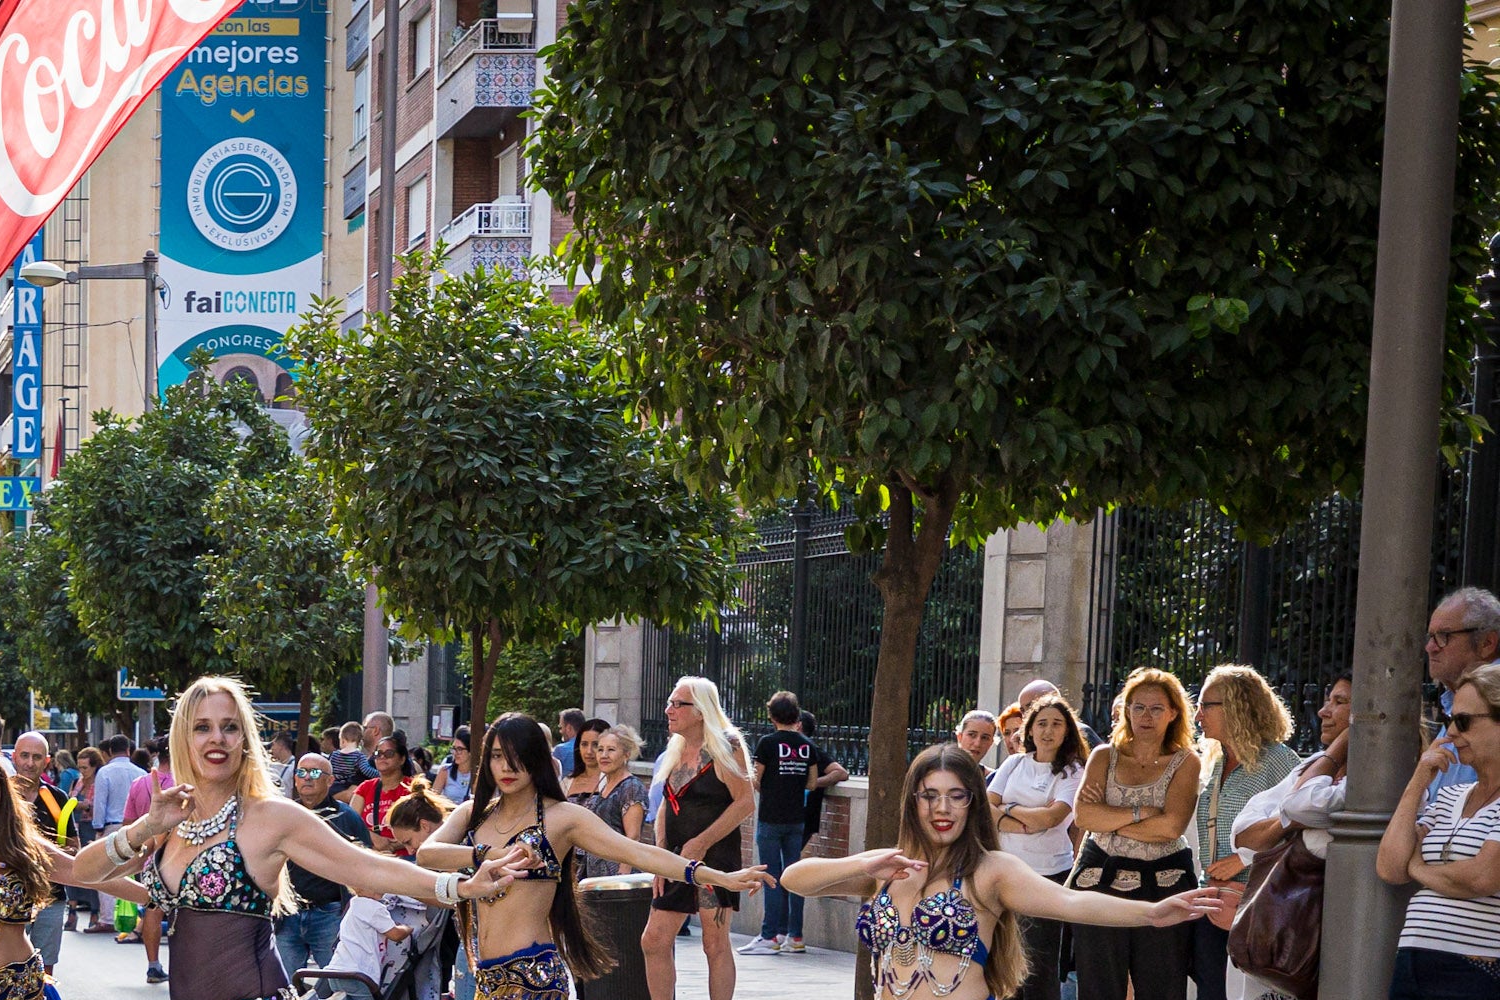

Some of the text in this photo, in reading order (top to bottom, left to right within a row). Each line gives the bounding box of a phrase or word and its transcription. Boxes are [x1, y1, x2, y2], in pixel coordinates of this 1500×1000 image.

[216, 19, 270, 33] con las
[187, 40, 299, 72] mejores
[176, 69, 309, 106] Agencias
[208, 227, 275, 247] EXCLUSIVOS
